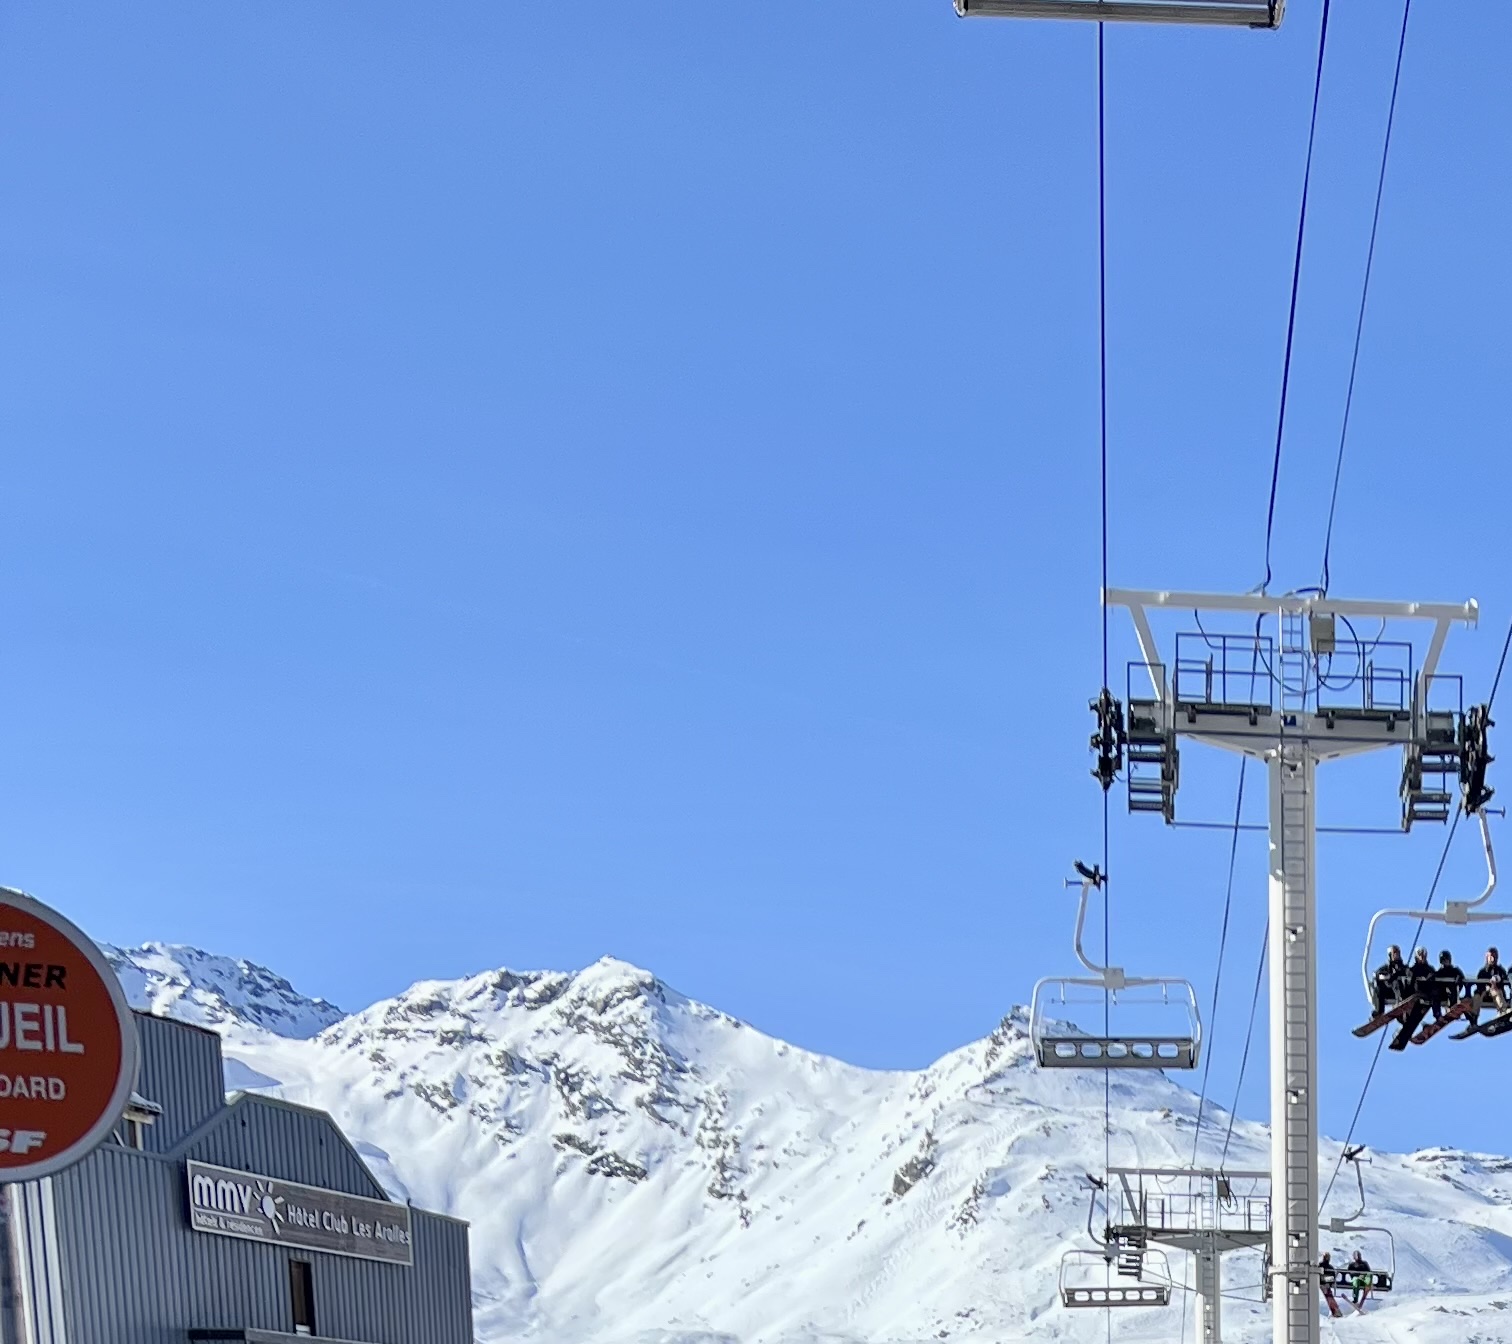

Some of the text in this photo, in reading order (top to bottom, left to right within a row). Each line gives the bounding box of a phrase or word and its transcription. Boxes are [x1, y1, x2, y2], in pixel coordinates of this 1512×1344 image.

[287, 1203, 320, 1231] Hôtel
[322, 1210, 349, 1235] Club
[351, 1215, 372, 1239] Les
